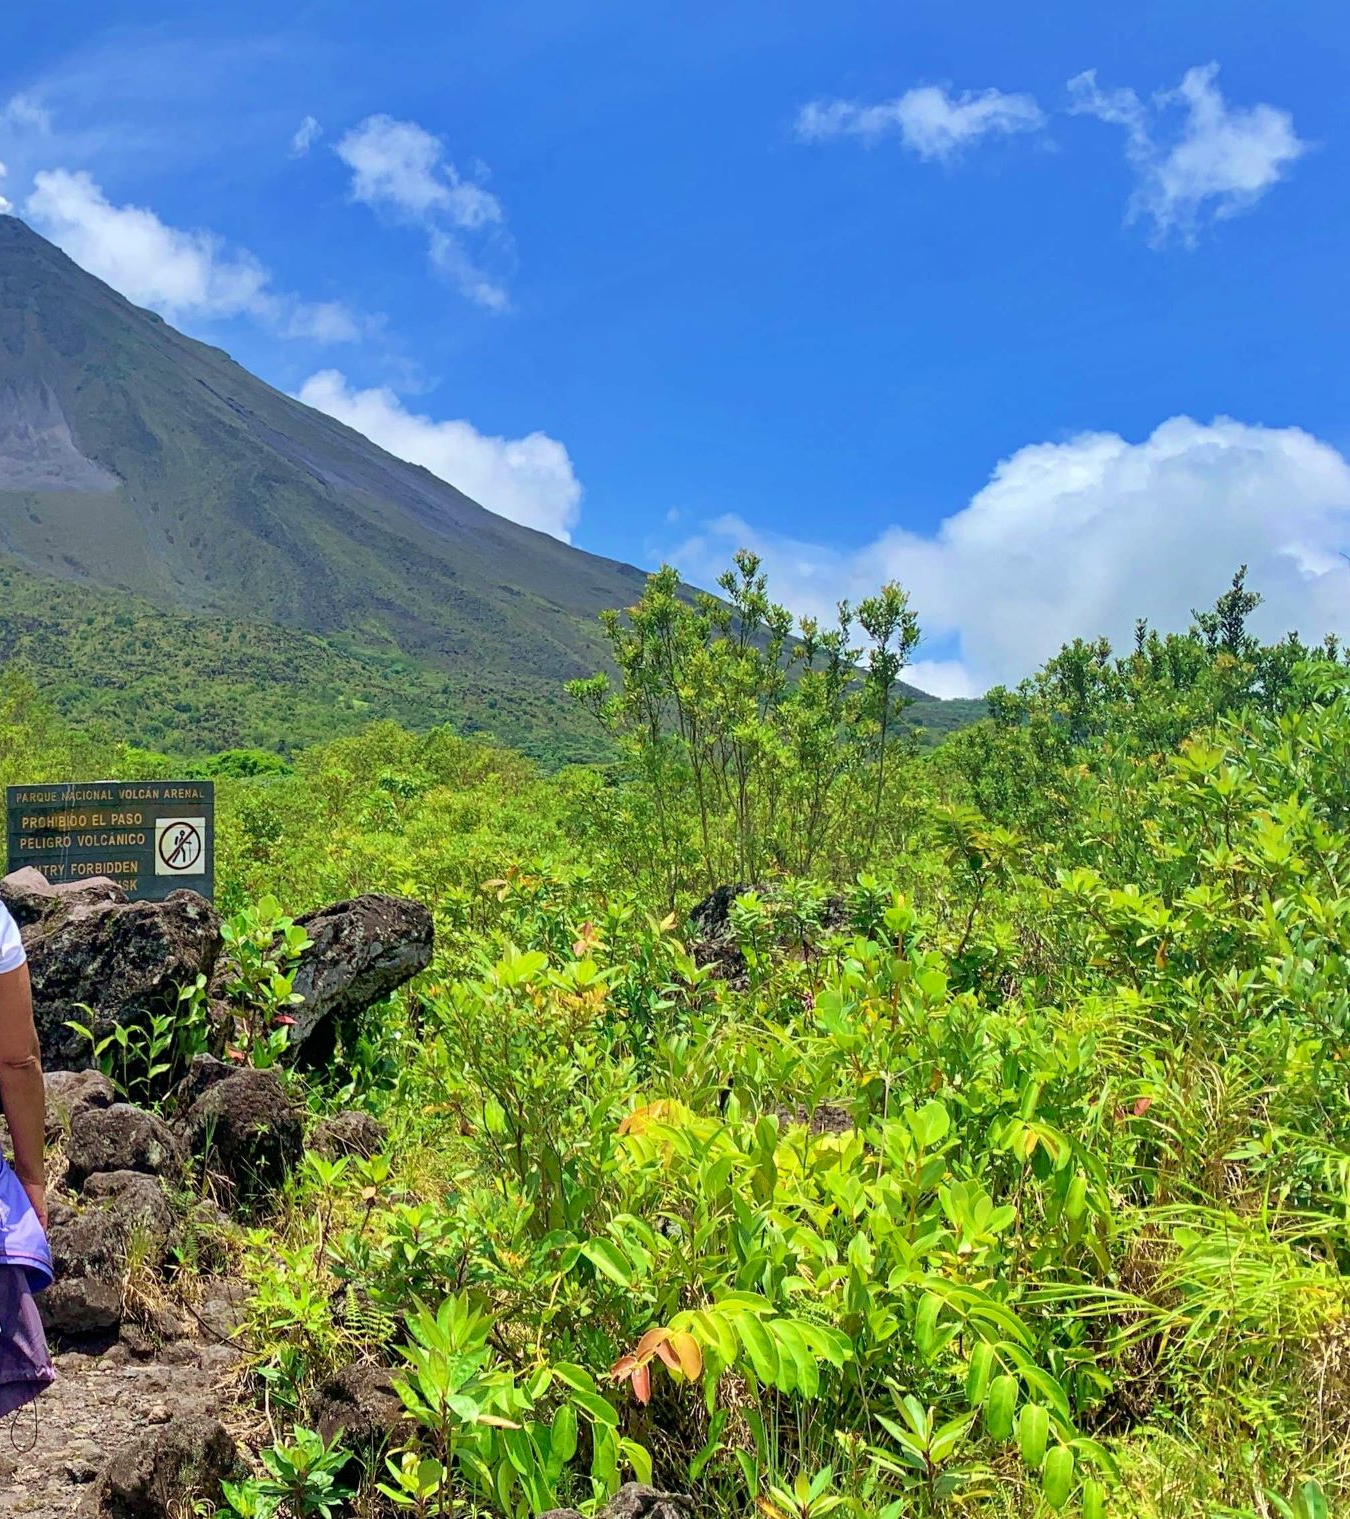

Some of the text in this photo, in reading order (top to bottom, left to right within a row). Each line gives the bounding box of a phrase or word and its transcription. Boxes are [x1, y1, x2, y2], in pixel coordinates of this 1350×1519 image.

[16, 786, 205, 804] PARQUE NACIONAL VOLCÁN ARENAL
[22, 813, 142, 829] PROHIBIDO EL PASO
[20, 832, 145, 849] PELIGRO VOLCÁNICO
[71, 860, 139, 875] FORBIDDEN
